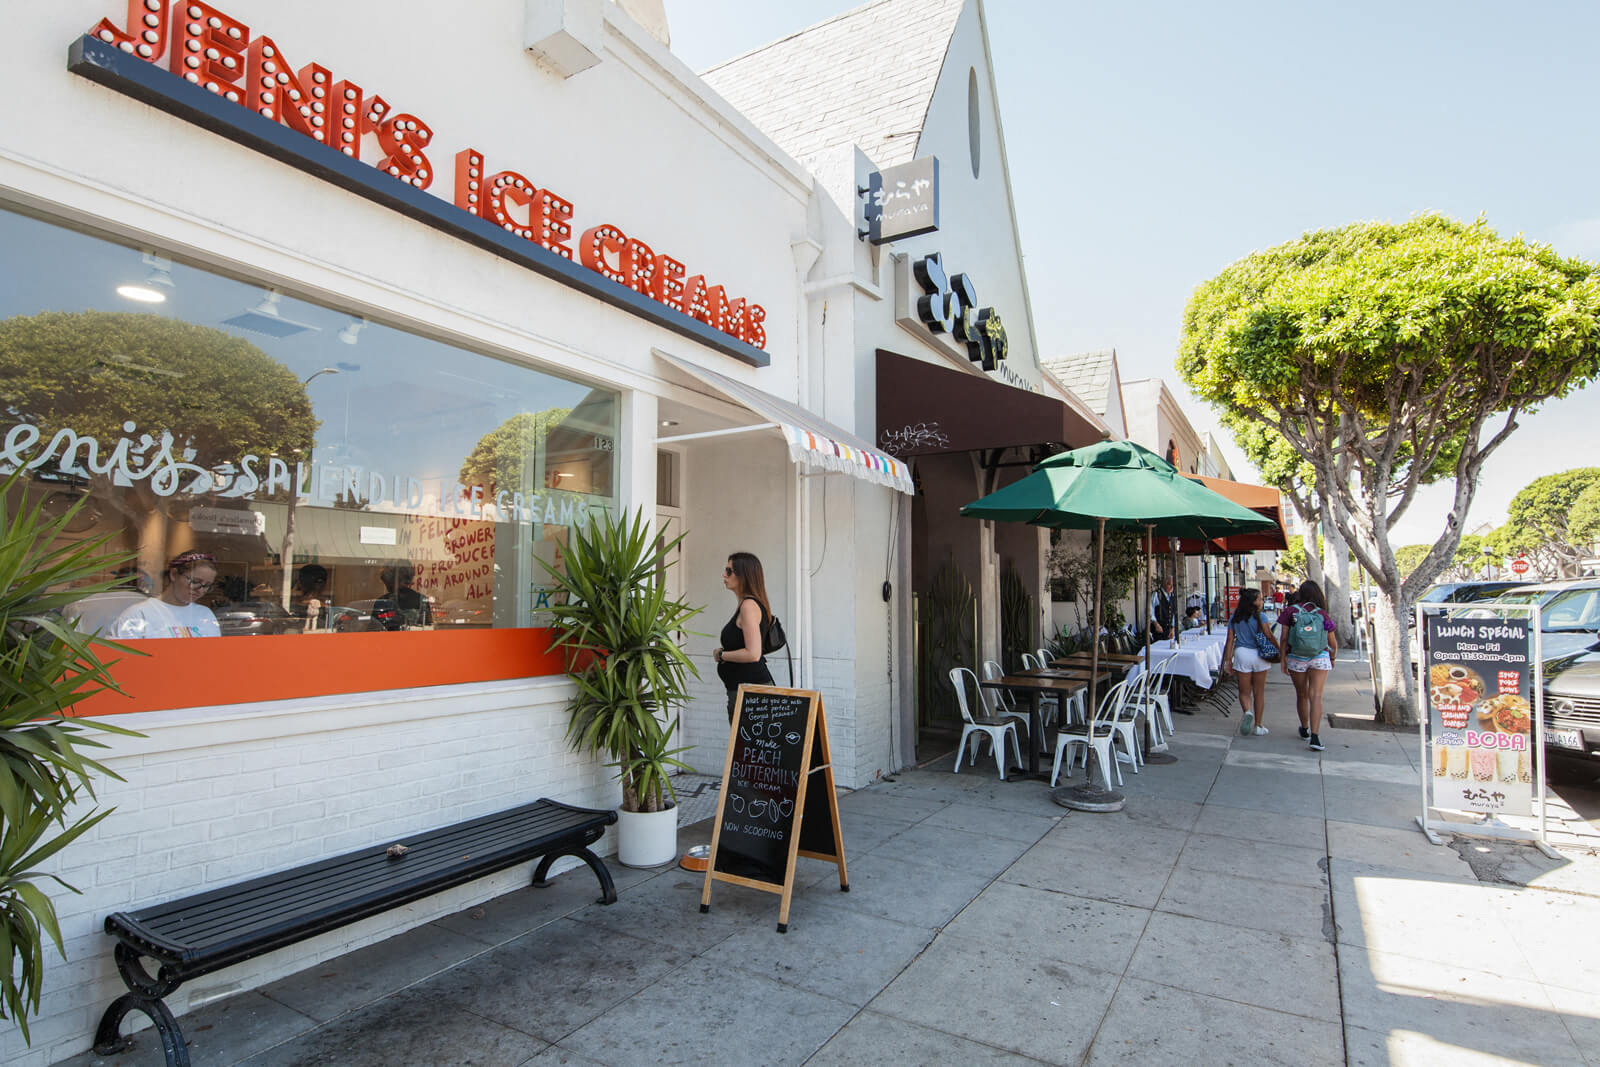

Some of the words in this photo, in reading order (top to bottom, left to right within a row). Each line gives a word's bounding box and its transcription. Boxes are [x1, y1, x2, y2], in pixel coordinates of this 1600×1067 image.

[88, 0, 434, 191] JENI'S
[454, 148, 574, 262] ICE
[579, 224, 767, 350] CREAMS
[1000, 361, 1033, 391] muray
[0, 420, 213, 497] eni's
[241, 454, 424, 509] SPLENDID
[441, 481, 483, 515] ICE
[497, 490, 588, 529] CREAMS
[444, 527, 496, 554] GROWER
[444, 564, 489, 590] AROUND
[466, 583, 493, 600] ALL
[1437, 625, 1475, 639] LUNCH
[1479, 626, 1526, 640] SPECIAL
[1434, 651, 1460, 661] Open
[1457, 642, 1478, 651] Mon
[1485, 643, 1500, 651] Fri
[1466, 730, 1526, 751] BOBA
[743, 747, 782, 766] PEACH
[731, 761, 799, 788] BUTTERMILK
[753, 782, 782, 793] CREAM
[1462, 788, 1505, 802] むらや
[723, 821, 740, 832] NOW
[743, 824, 784, 840] SCOOPING
